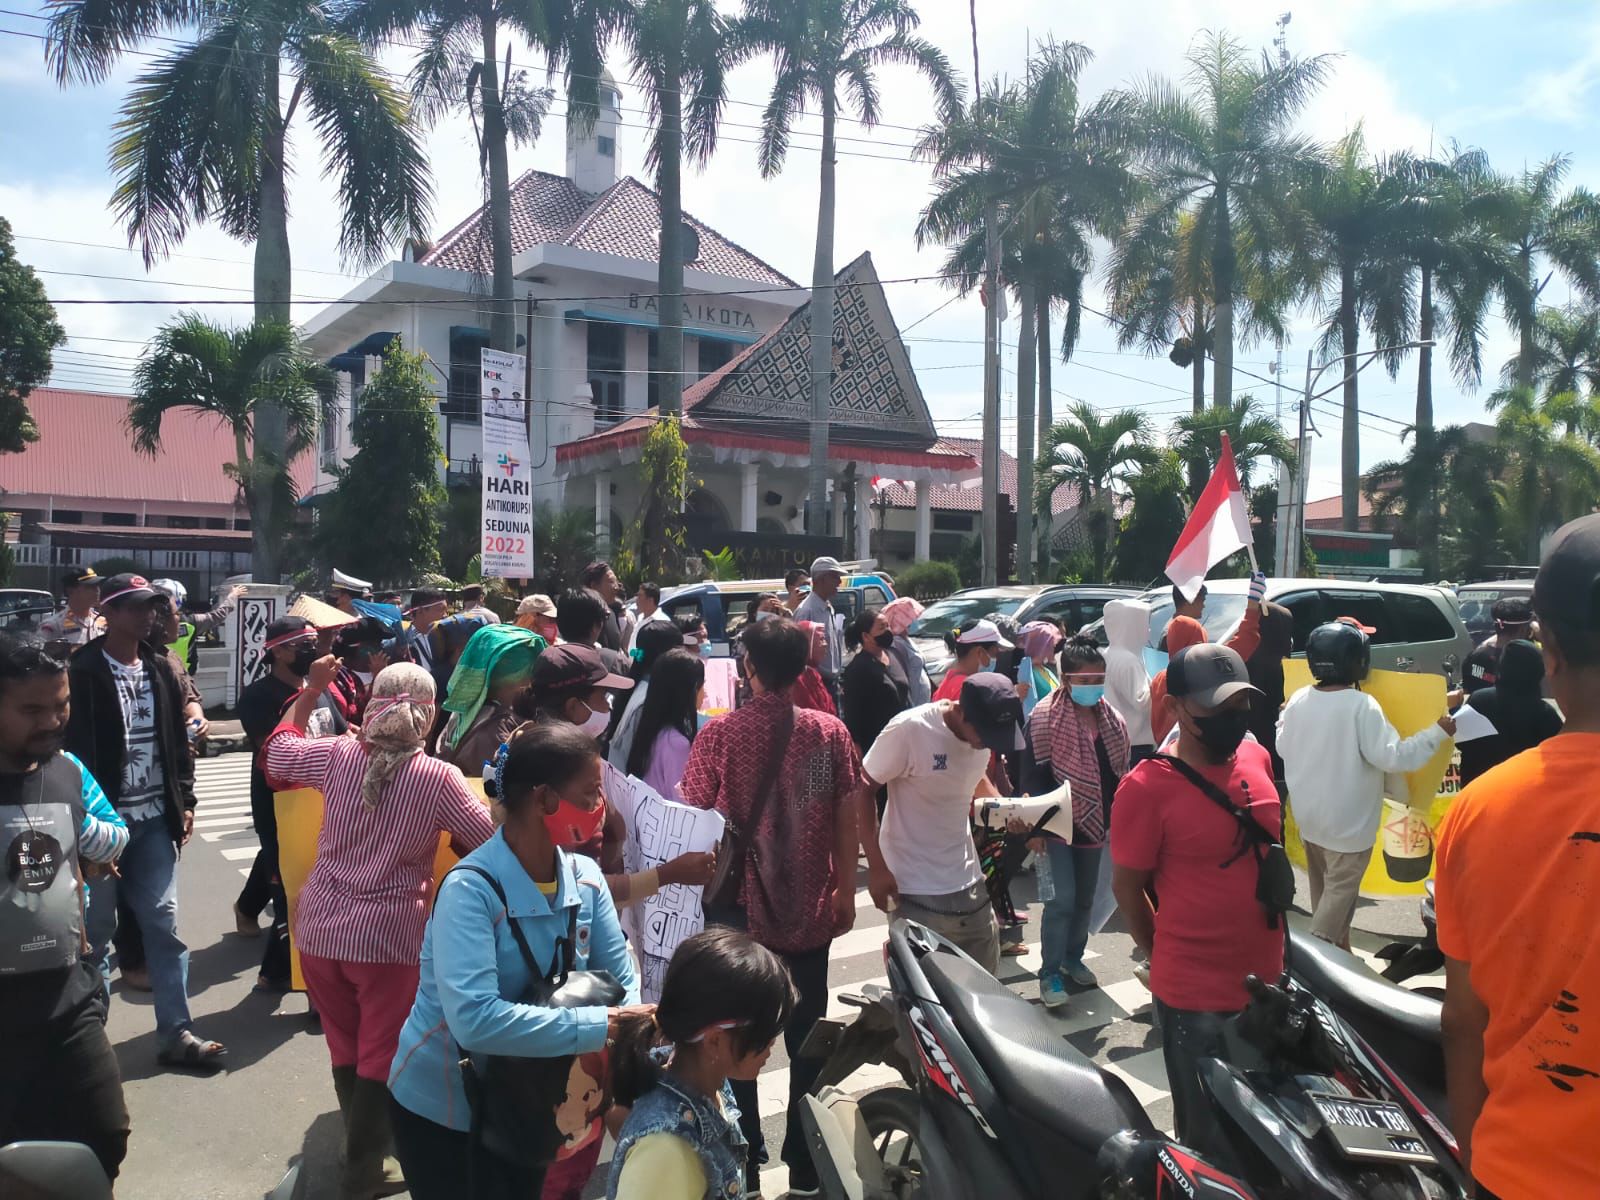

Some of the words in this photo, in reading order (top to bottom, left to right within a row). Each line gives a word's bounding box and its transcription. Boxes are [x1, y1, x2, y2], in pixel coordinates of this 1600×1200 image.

[483, 369, 502, 381] KPK
[487, 476, 529, 496] HARI
[486, 498, 531, 515] ANTIKORUPSI
[485, 518, 531, 534] SEDUNIA
[485, 535, 526, 554] 2022
[1158, 1148, 1195, 1200] HONDA
